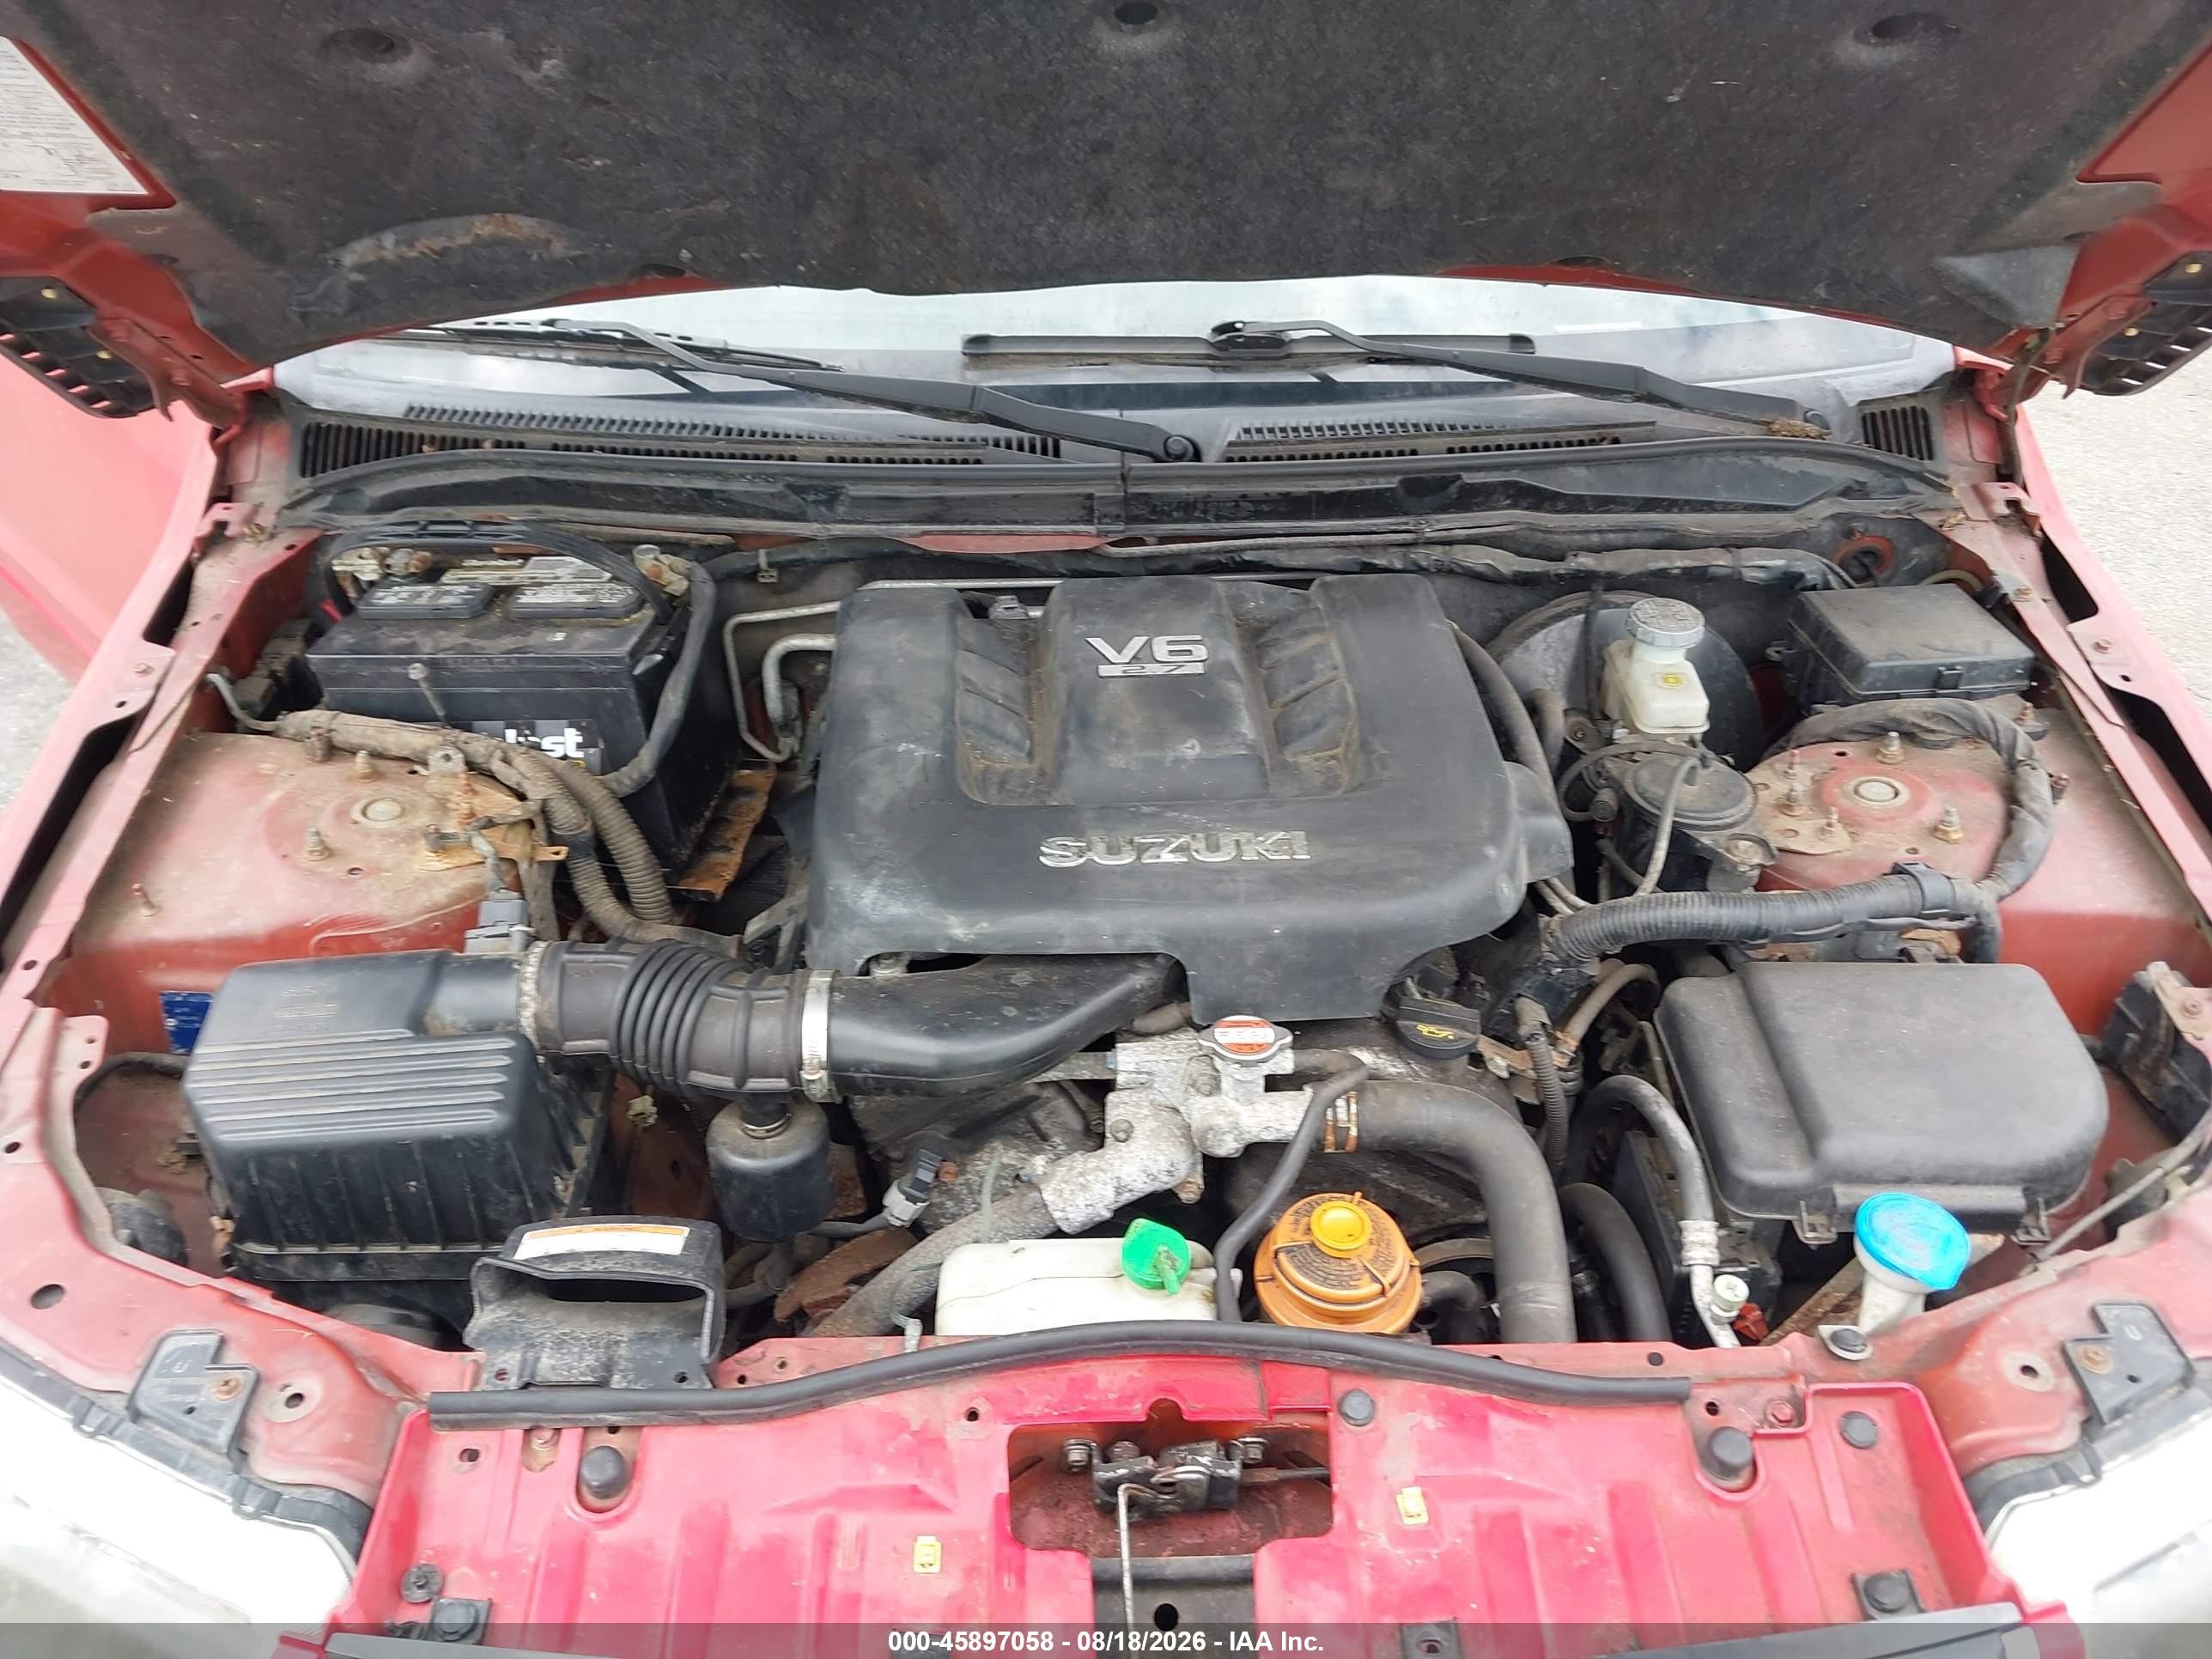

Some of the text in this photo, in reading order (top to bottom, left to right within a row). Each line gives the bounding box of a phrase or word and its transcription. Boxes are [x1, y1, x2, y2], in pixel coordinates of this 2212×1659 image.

[1085, 635, 1209, 664] V6
[1121, 664, 1187, 674] 2.7
[1038, 830, 1312, 868] SUZUKI
